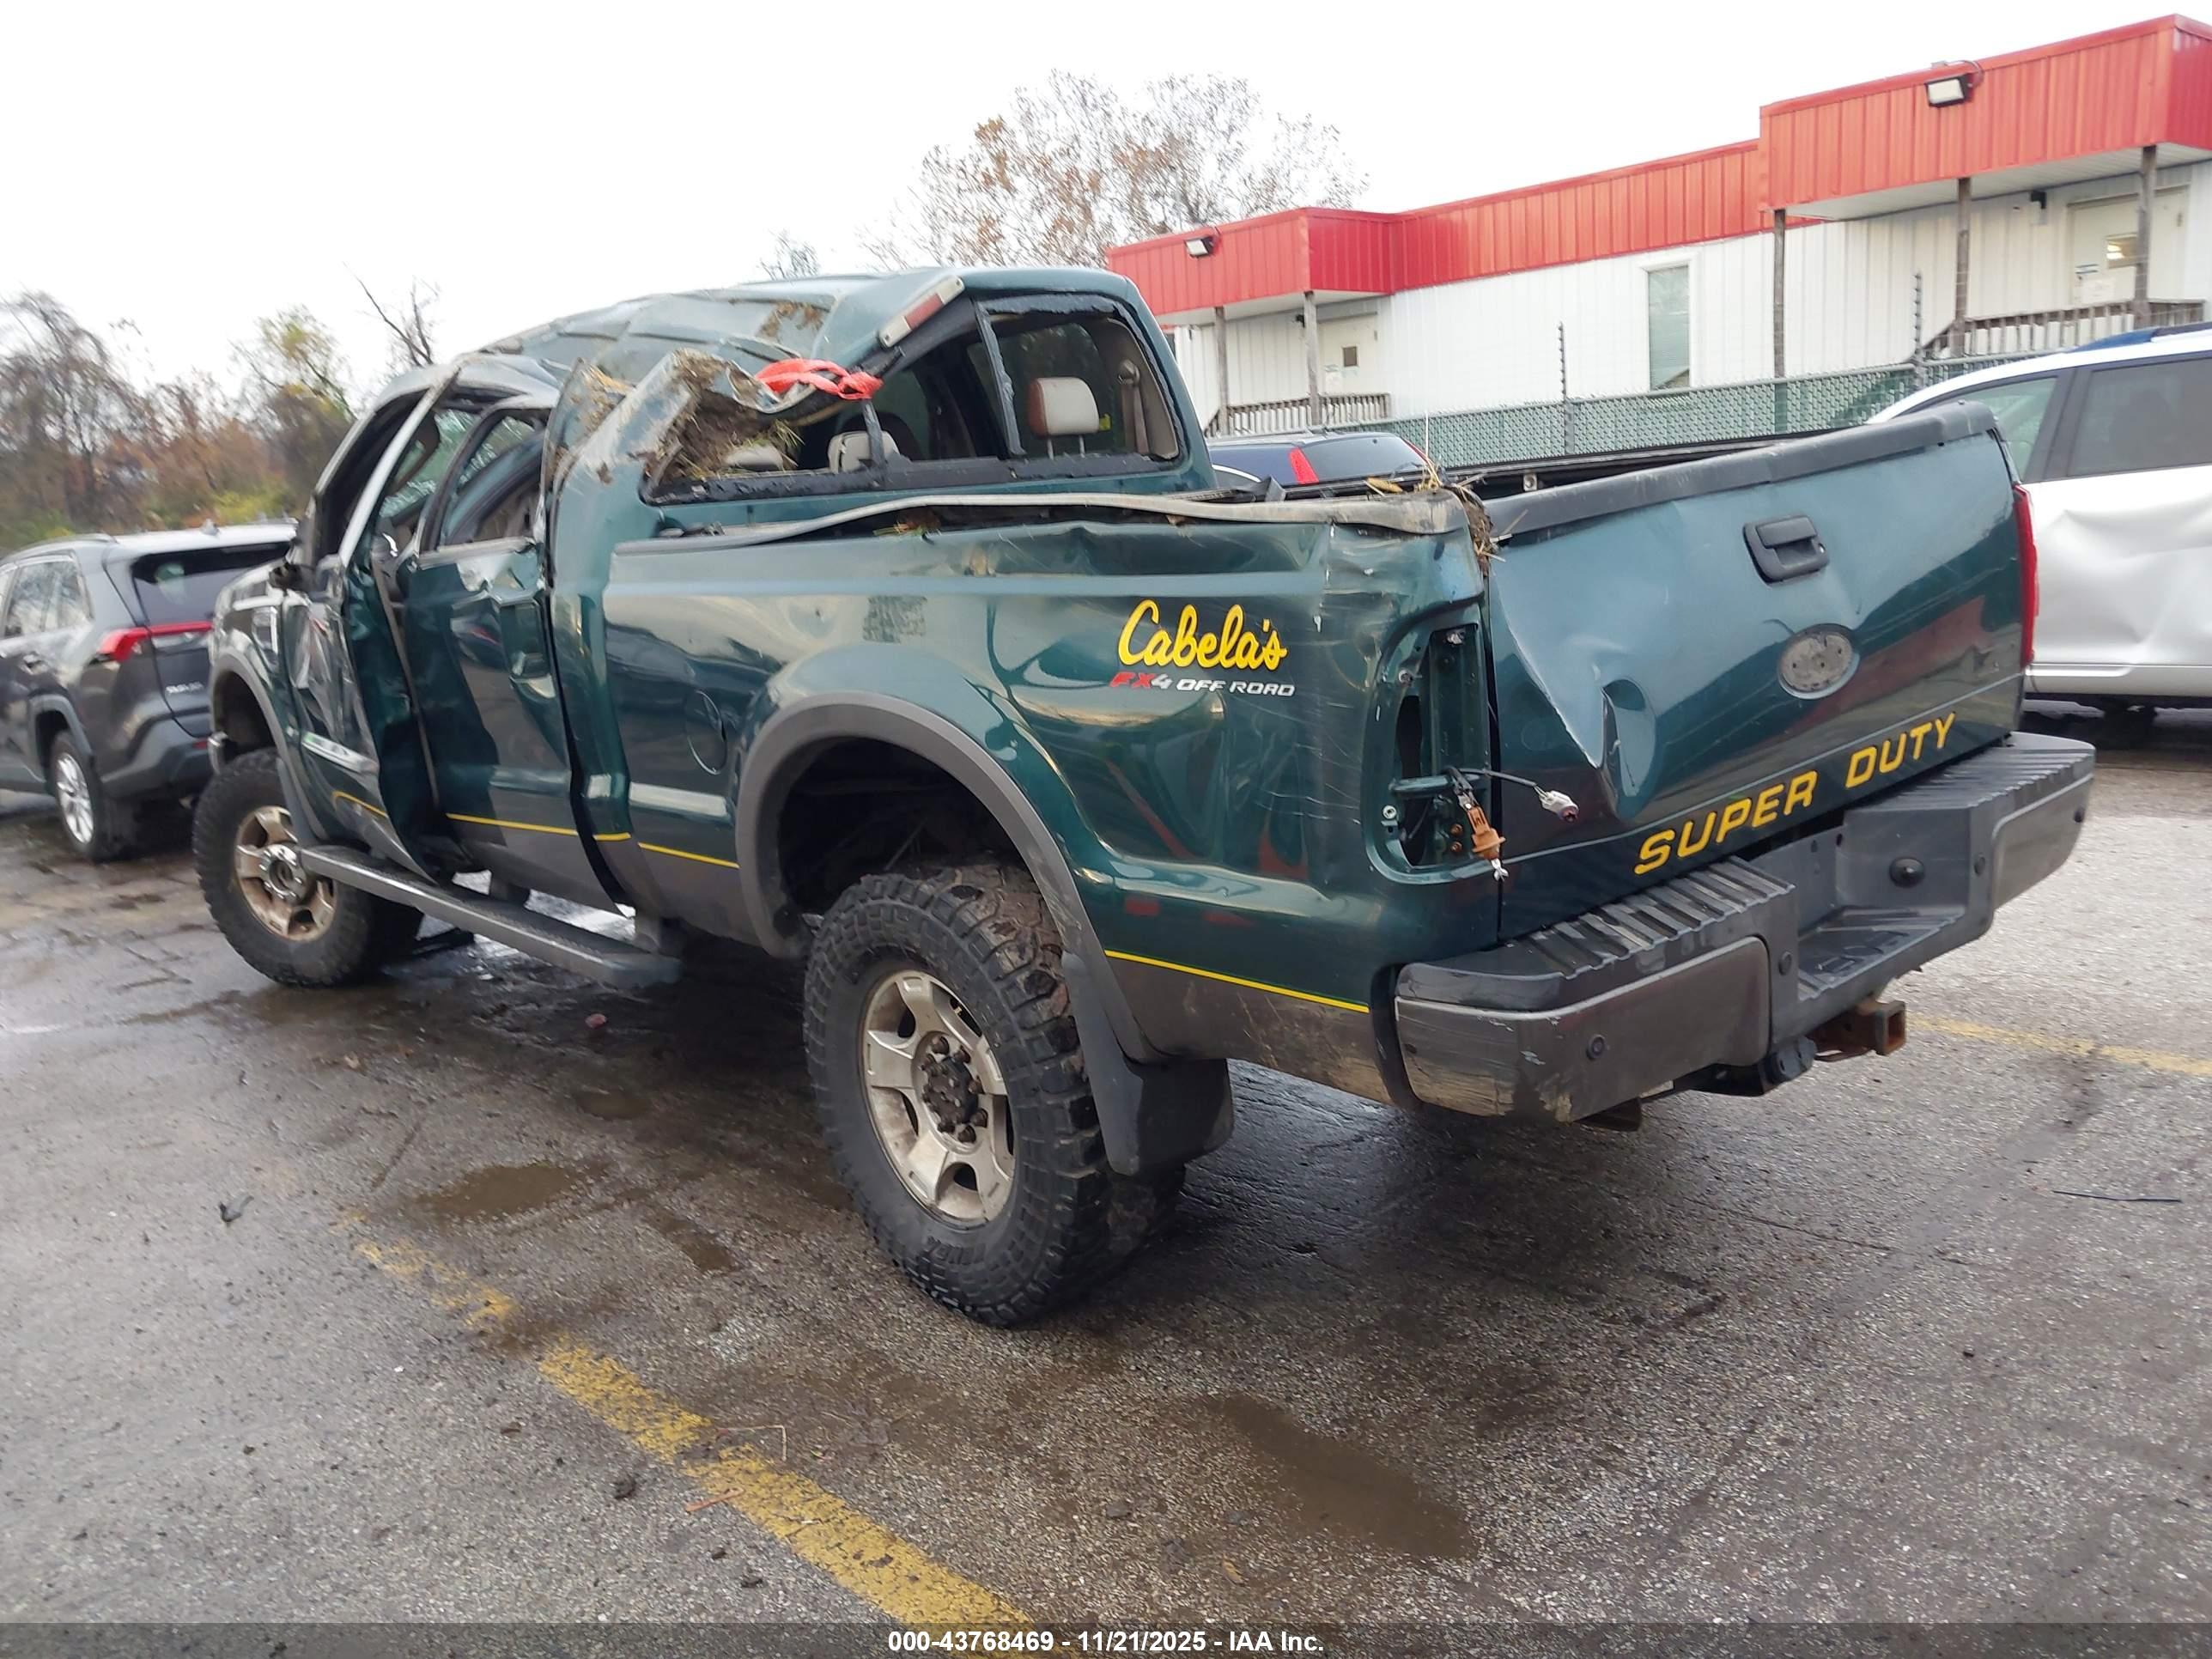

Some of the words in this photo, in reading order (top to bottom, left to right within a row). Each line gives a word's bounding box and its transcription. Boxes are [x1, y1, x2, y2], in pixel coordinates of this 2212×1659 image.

[1118, 599, 1288, 671] Cabela's
[1109, 672, 1173, 690] FX4
[1176, 678, 1226, 692] OFF
[1229, 681, 1296, 696] ROAD
[1634, 770, 1819, 875] SUPER
[1845, 711, 1957, 789] DUTY
